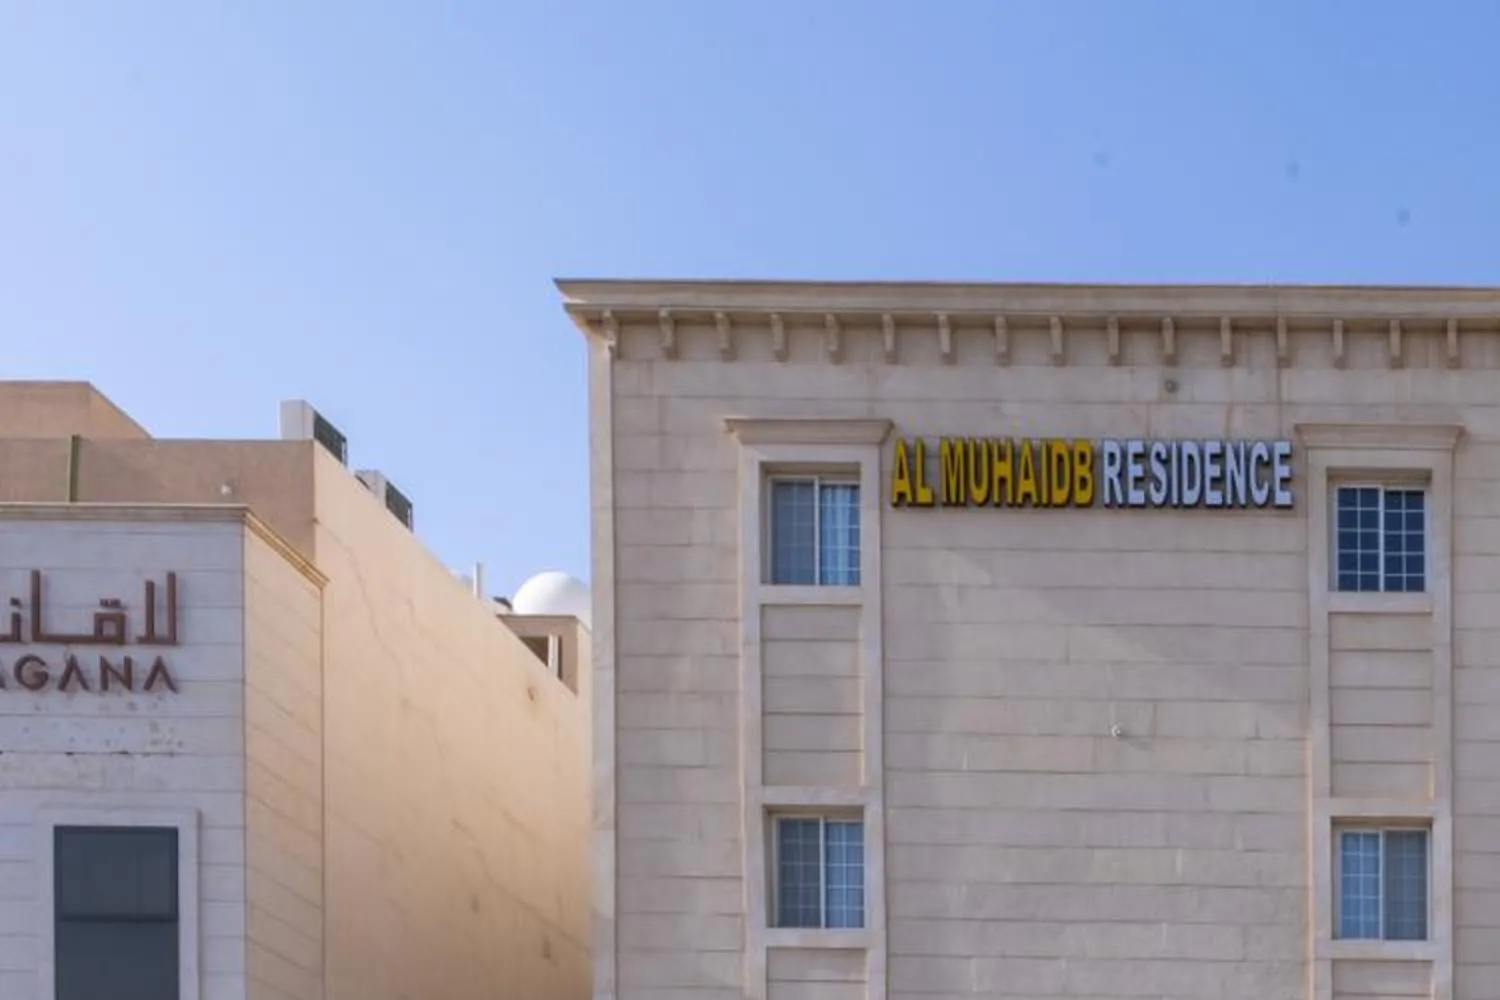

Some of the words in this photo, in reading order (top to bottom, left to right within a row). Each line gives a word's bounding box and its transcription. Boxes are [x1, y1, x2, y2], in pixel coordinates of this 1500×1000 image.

[891, 435, 934, 508] AL
[939, 435, 1096, 508] MUHAIDB
[1101, 437, 1295, 509] RESIDENCE
[0, 569, 178, 646] لاقان
[0, 653, 179, 694] GANA
